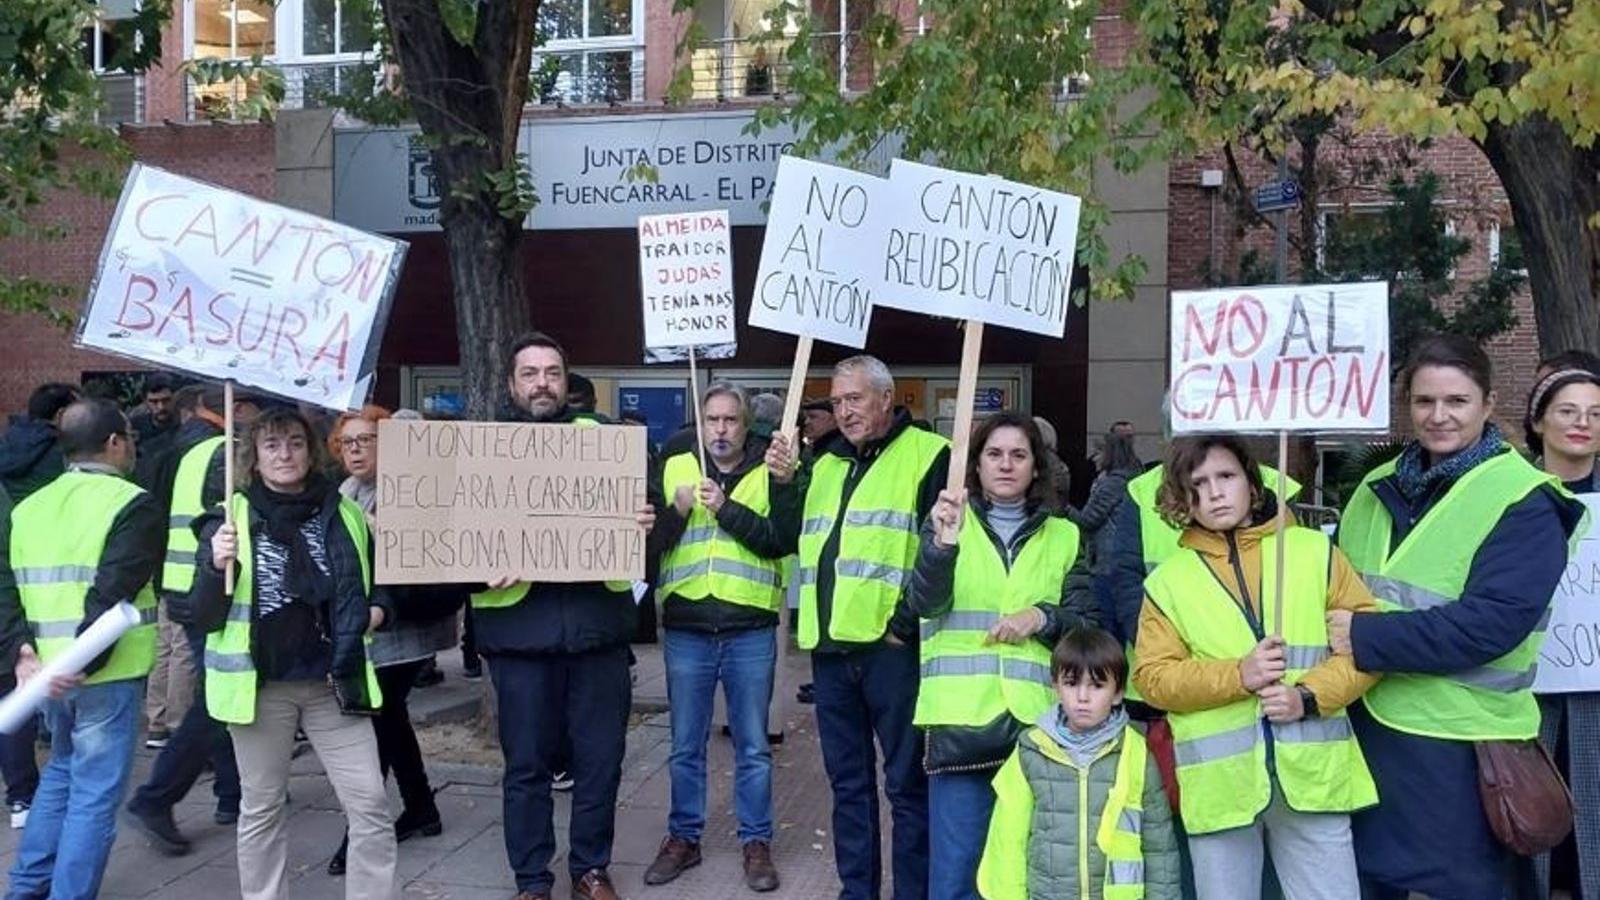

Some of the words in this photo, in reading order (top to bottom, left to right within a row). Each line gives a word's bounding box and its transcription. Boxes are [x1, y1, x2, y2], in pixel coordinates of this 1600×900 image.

[580, 145, 652, 175] JUNTA
[658, 146, 686, 165] DE
[552, 182, 696, 205] FUENCARRAL
[718, 177, 744, 200] EL
[806, 175, 868, 228] NO
[920, 180, 1058, 246] CANTÓN
[641, 216, 726, 237] ALMEIDA
[781, 224, 838, 276] AL
[657, 262, 721, 284] JUDAS
[884, 228, 1071, 323] REUBICACIÓN
[665, 315, 728, 331] HONOR
[760, 271, 871, 330] CANTÓN
[115, 273, 350, 381] BASURA
[1183, 294, 1268, 362] NO
[1279, 291, 1365, 357] AL
[408, 424, 628, 464] MONTECARMELO
[381, 473, 497, 510] DECLARA
[503, 474, 520, 509] A
[521, 529, 569, 570] NON
[577, 528, 642, 573] GRATA
